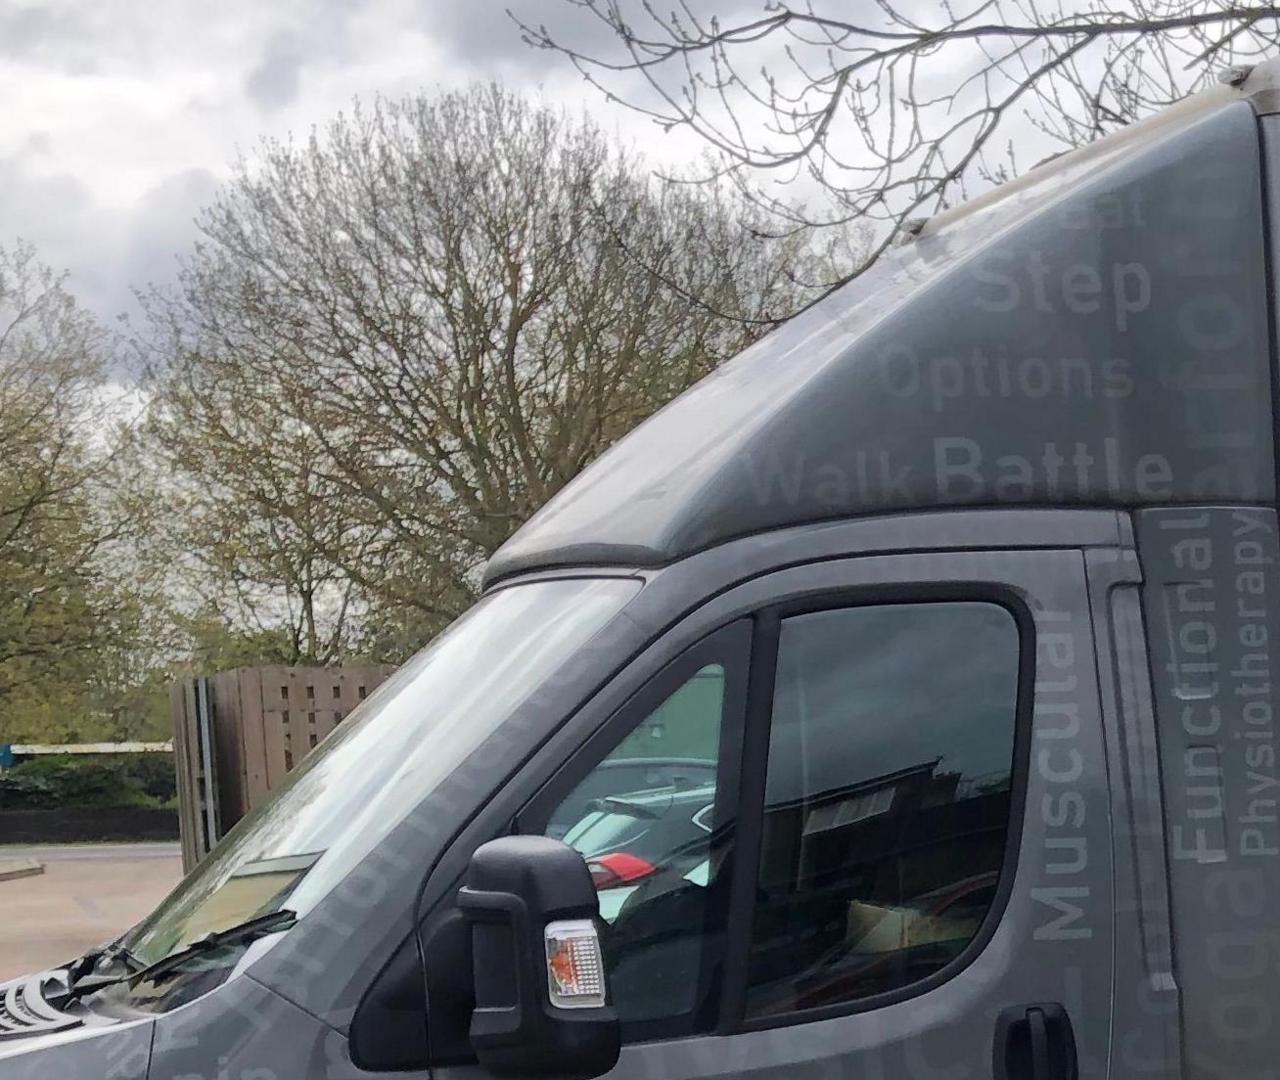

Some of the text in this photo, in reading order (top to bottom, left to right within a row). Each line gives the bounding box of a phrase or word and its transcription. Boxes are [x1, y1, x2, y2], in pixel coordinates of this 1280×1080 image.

[971, 250, 1150, 333] Step
[878, 343, 1135, 413] Options
[743, 436, 1174, 504] Walk Battle
[1160, 511, 1229, 864] Functional
[1031, 609, 1093, 941] Muscular
